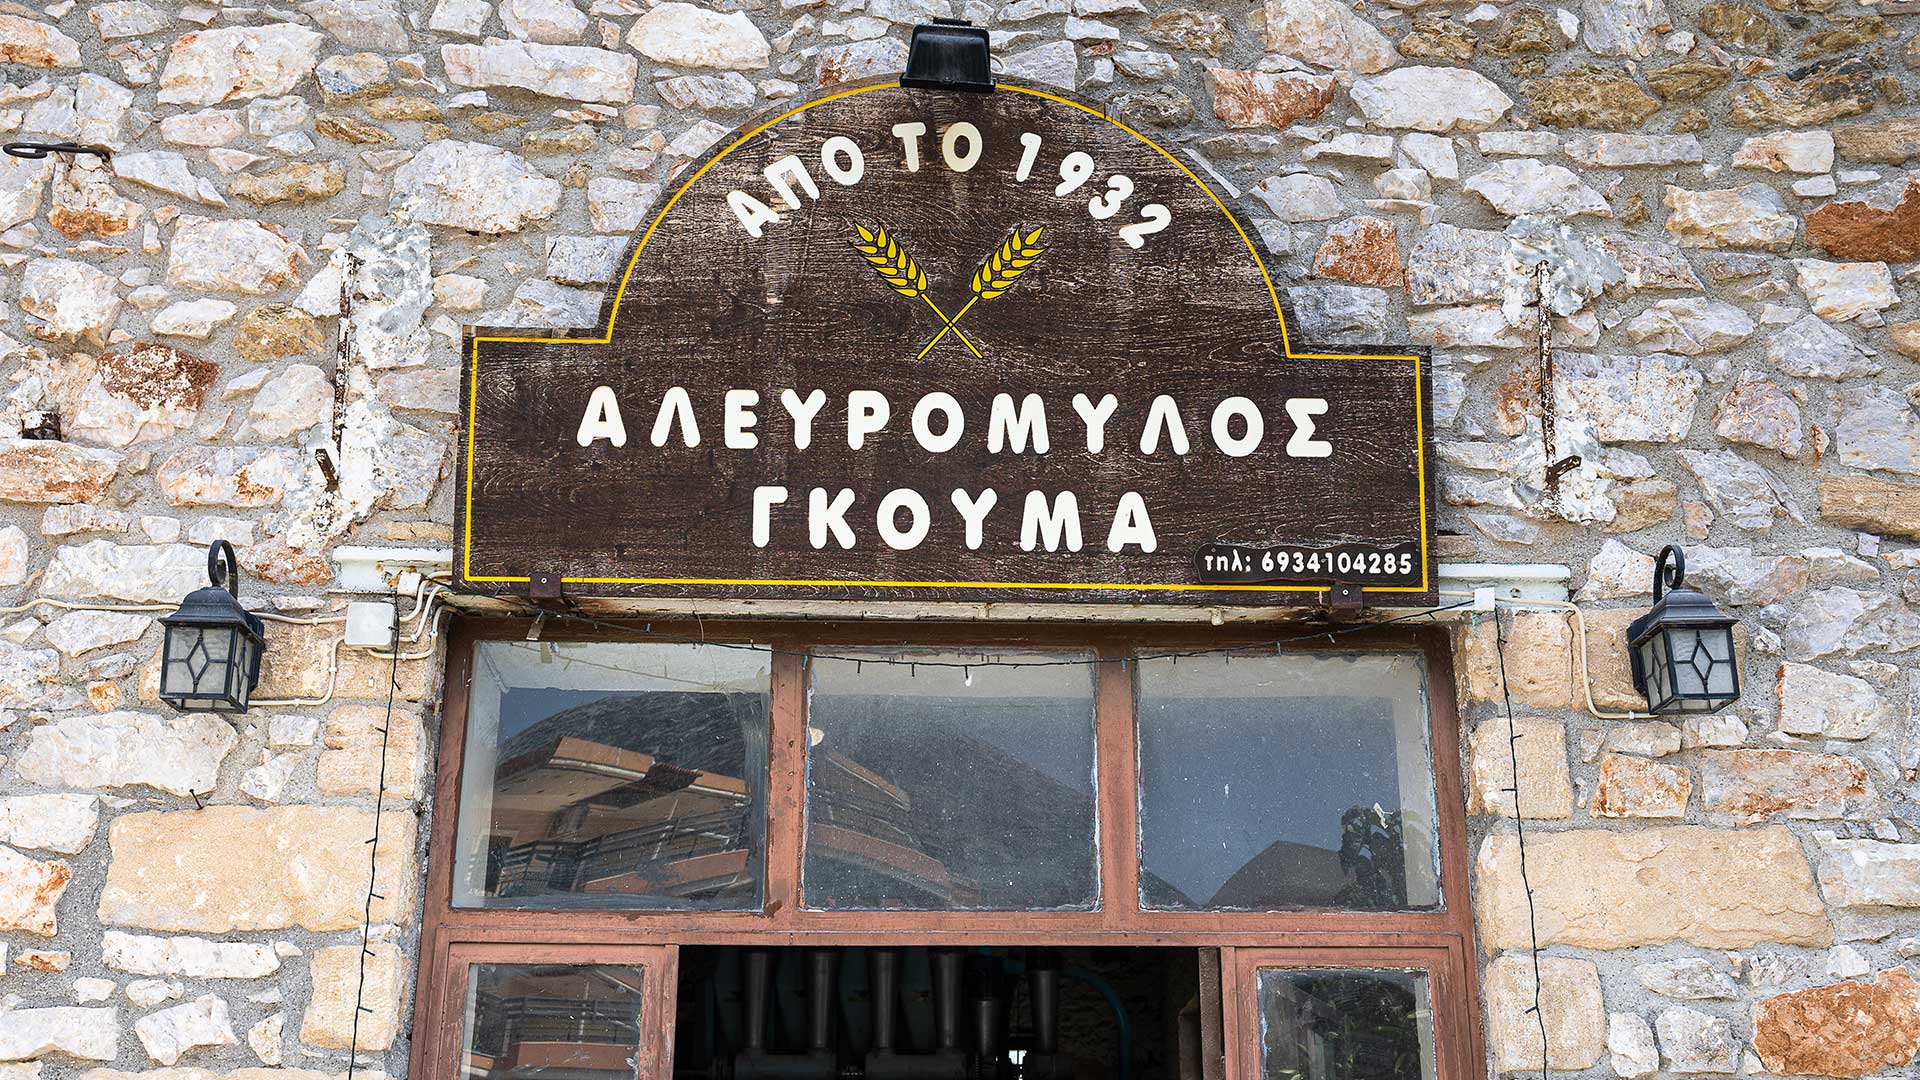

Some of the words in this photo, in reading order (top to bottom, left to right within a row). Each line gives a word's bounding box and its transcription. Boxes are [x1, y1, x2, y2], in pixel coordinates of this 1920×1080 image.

[726, 135, 865, 239] ΑΠΟ
[892, 121, 983, 173] ΤΟ
[1016, 131, 1172, 249] 1932
[576, 386, 1333, 458] ΑΛΕΥΡΟΜΥΛΟΣ
[752, 486, 1157, 553] ΓΚΟΥΜΑ
[1261, 551, 1413, 575] 6934104285
